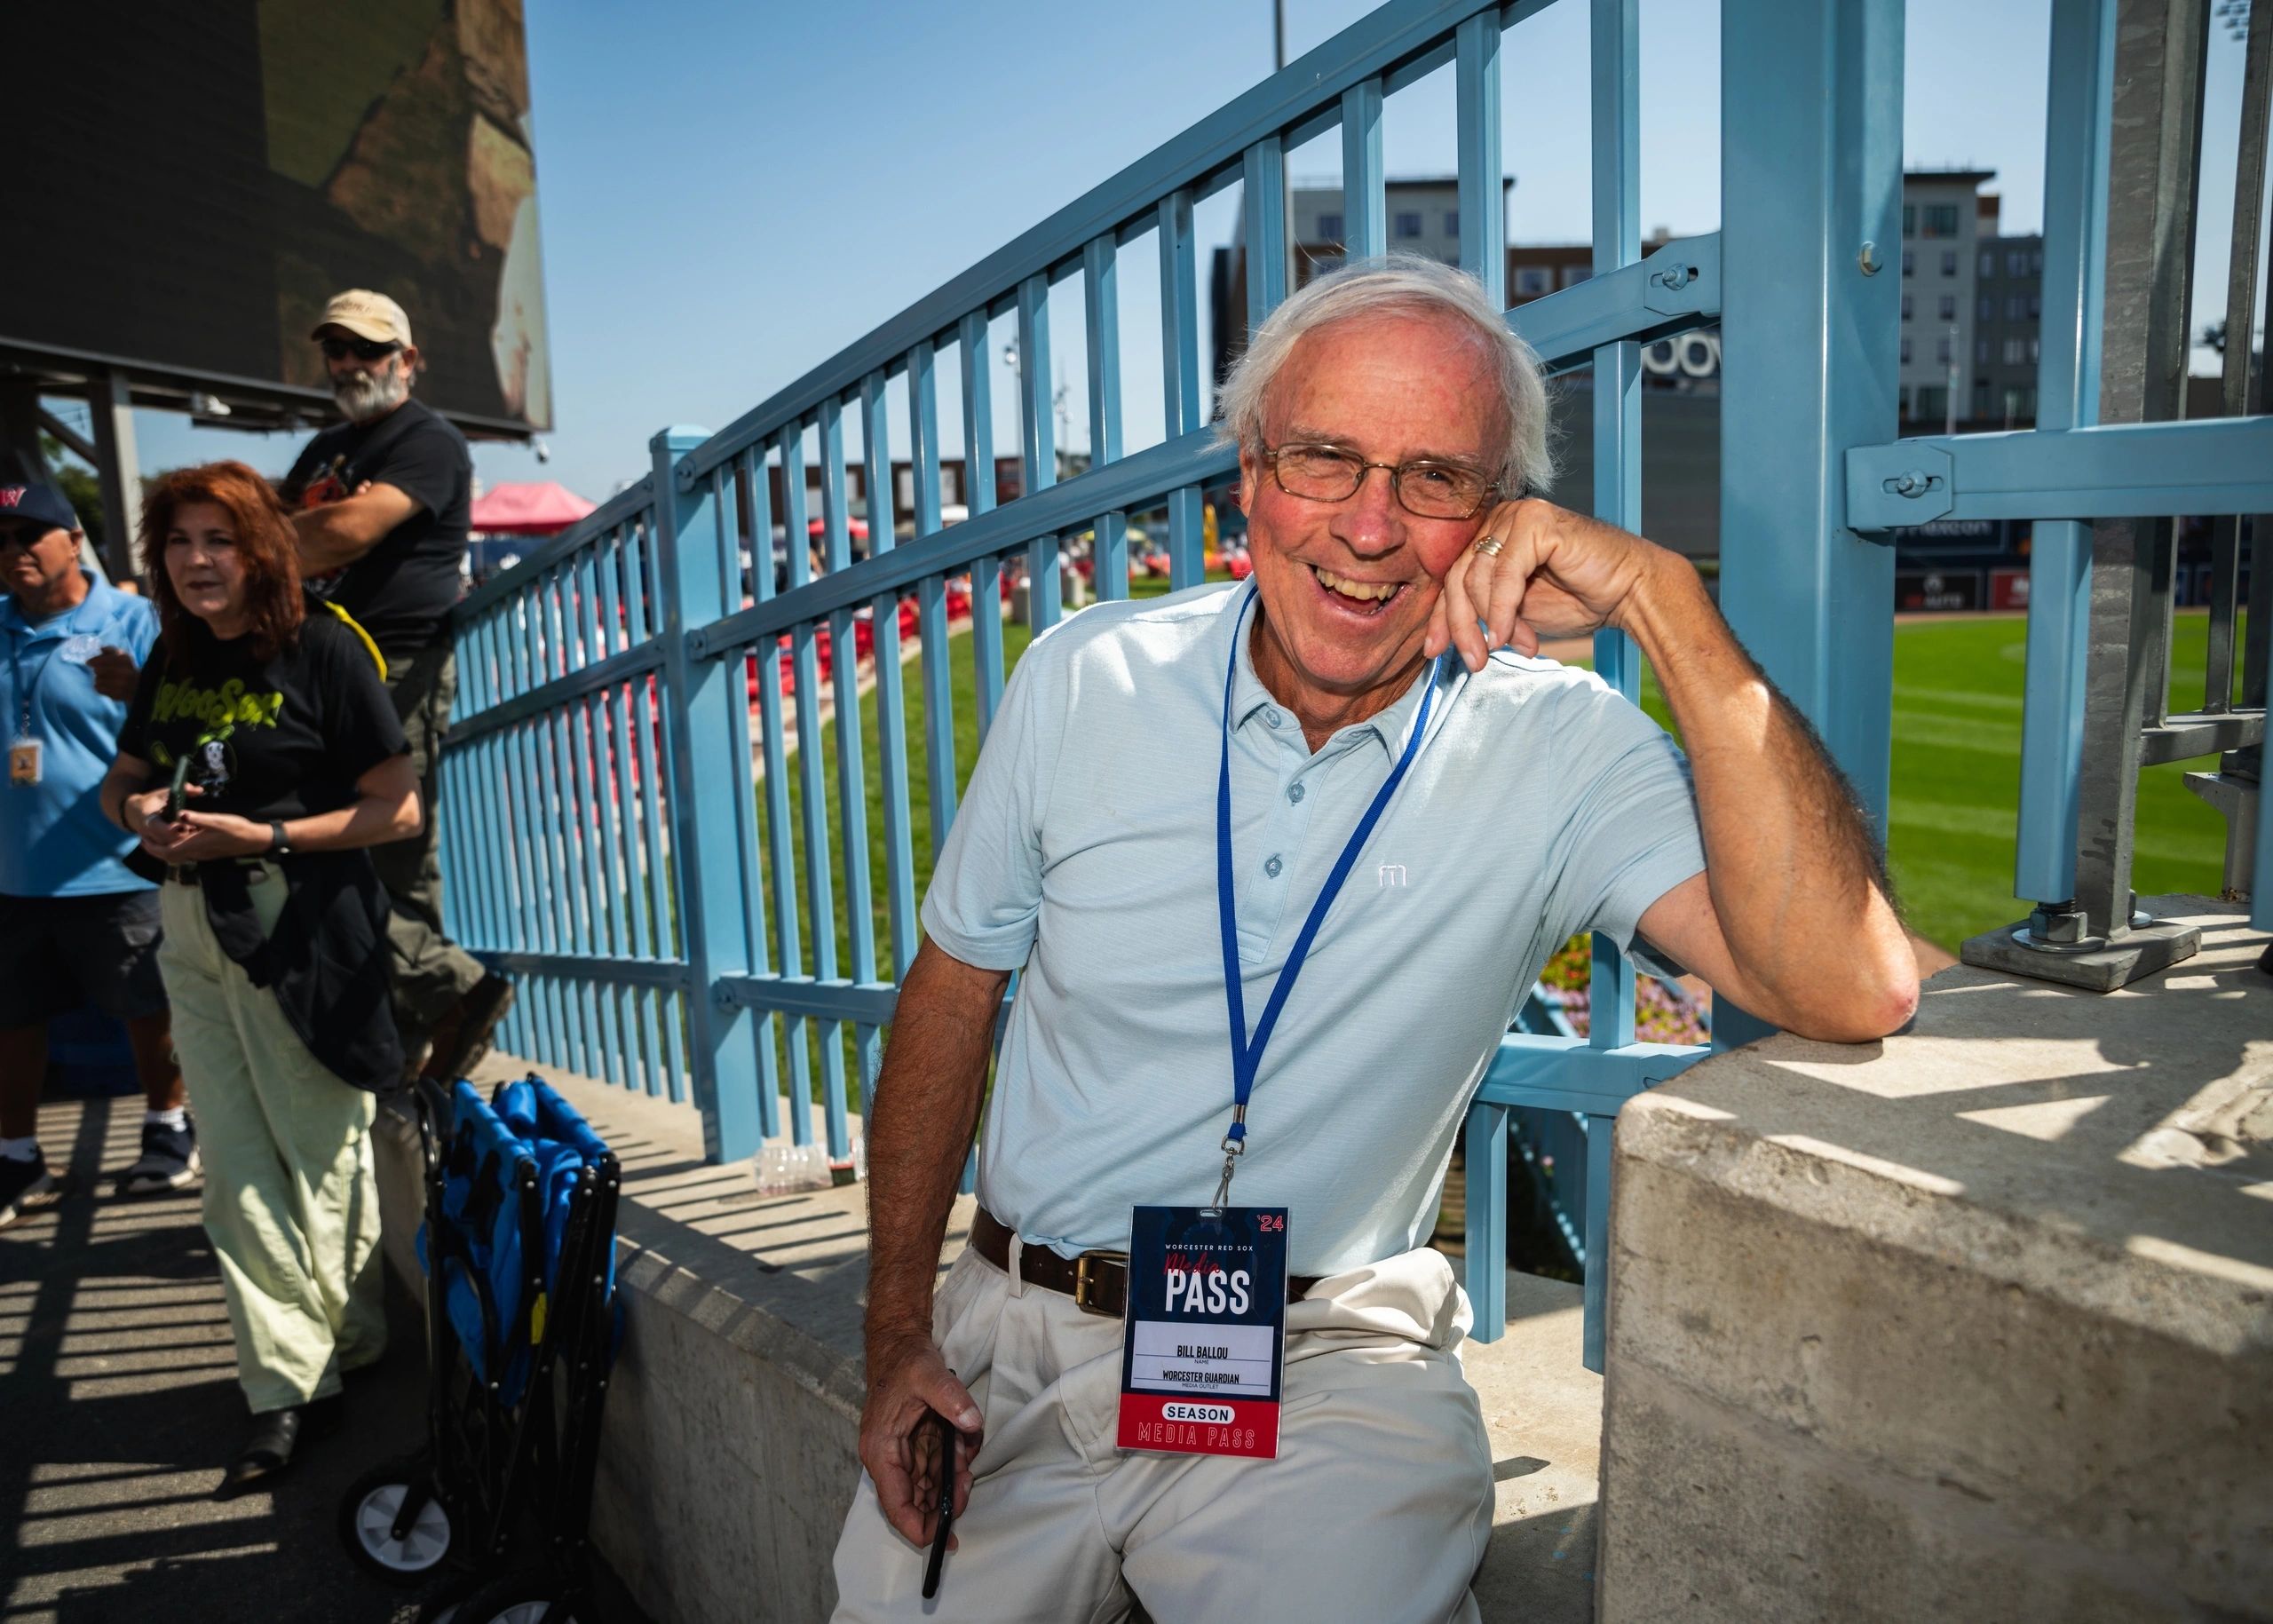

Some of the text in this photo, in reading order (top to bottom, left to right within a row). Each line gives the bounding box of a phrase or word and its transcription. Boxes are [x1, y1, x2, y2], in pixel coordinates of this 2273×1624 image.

[1163, 1251, 1222, 1277] Media
[1165, 1268, 1250, 1314] PASS
[1176, 1345, 1228, 1359] BILL BALLOU
[1162, 1370, 1239, 1384] WORCESTER GUARDIAN
[1167, 1406, 1229, 1422] SEASON
[1137, 1422, 1255, 1449] MEDIA PASS
